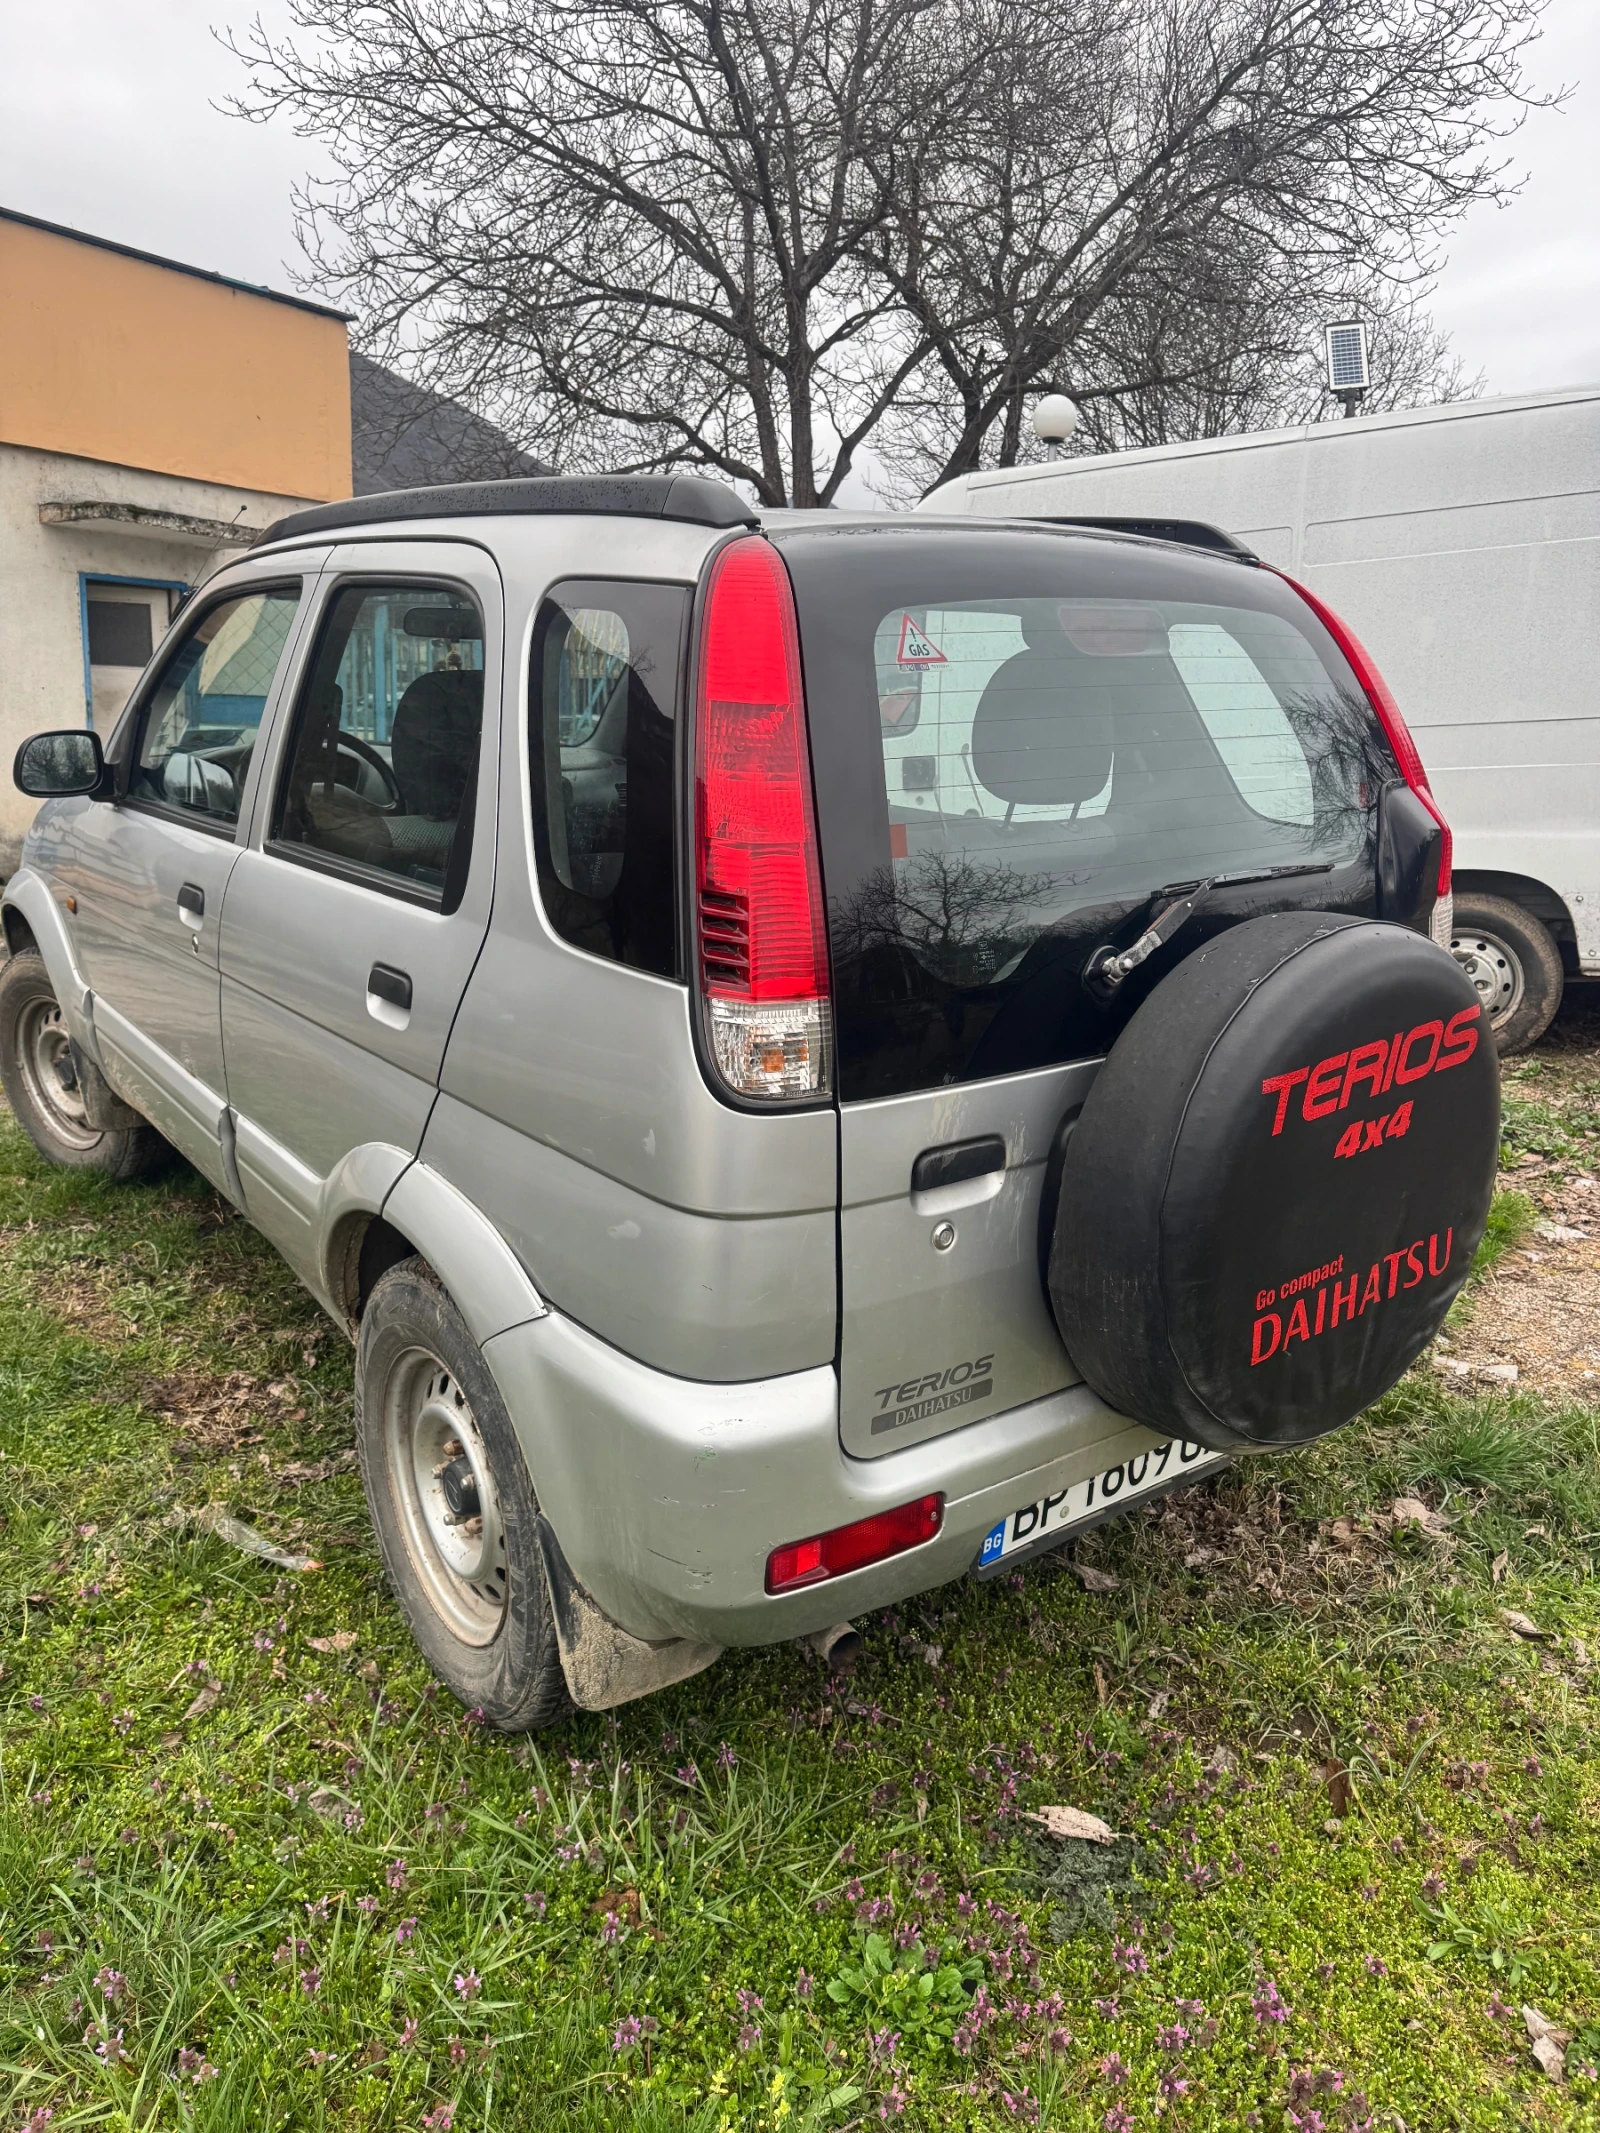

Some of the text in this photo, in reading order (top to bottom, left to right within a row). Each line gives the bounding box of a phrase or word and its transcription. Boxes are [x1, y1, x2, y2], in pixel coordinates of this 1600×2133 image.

[908, 644, 930, 657] GAS
[1262, 1003, 1481, 1137] TERIOS
[1333, 1100, 1414, 1159] 4x4
[1250, 1226, 1453, 1367] DAIHATSU
[1256, 1253, 1344, 1311] Go compact
[874, 1353, 995, 1410] TERIOS
[895, 1387, 972, 1426] DAIHATSU
[983, 1532, 1003, 1555] BG
